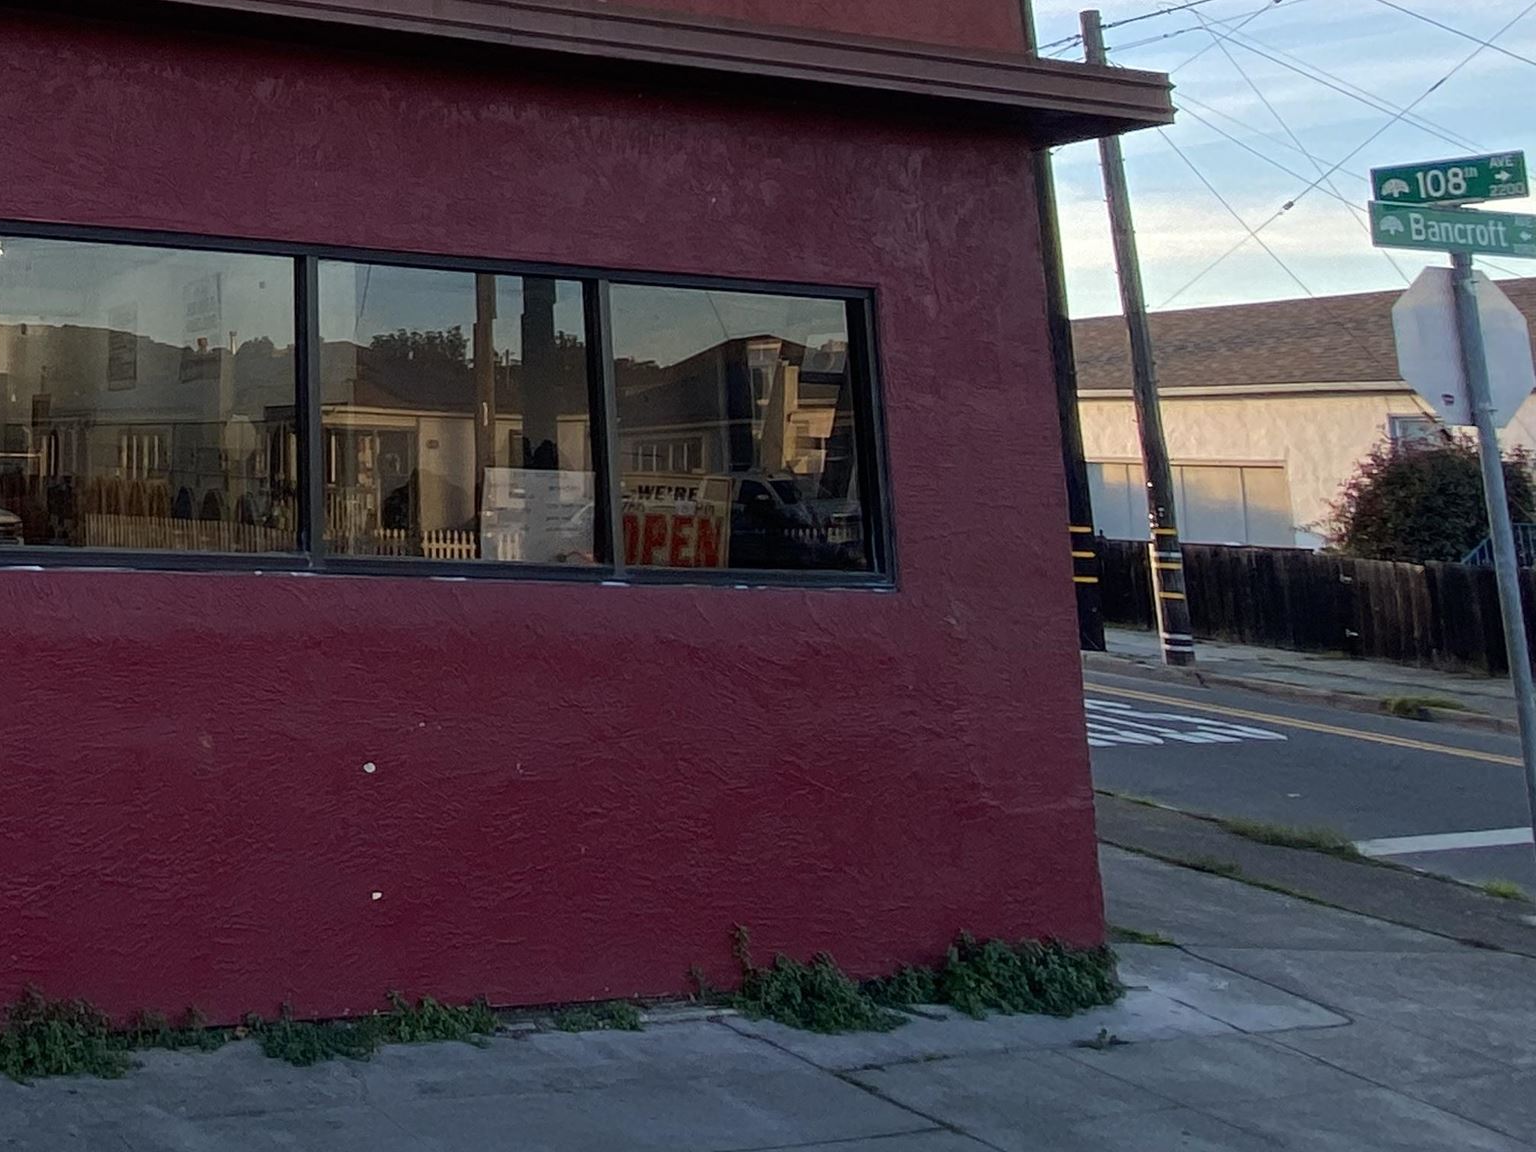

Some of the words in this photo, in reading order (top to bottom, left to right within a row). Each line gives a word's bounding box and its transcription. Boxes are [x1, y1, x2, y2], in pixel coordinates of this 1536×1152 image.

[1489, 155, 1514, 169] AVE
[1409, 213, 1509, 248] Bancroft
[638, 484, 700, 501] WE'RE
